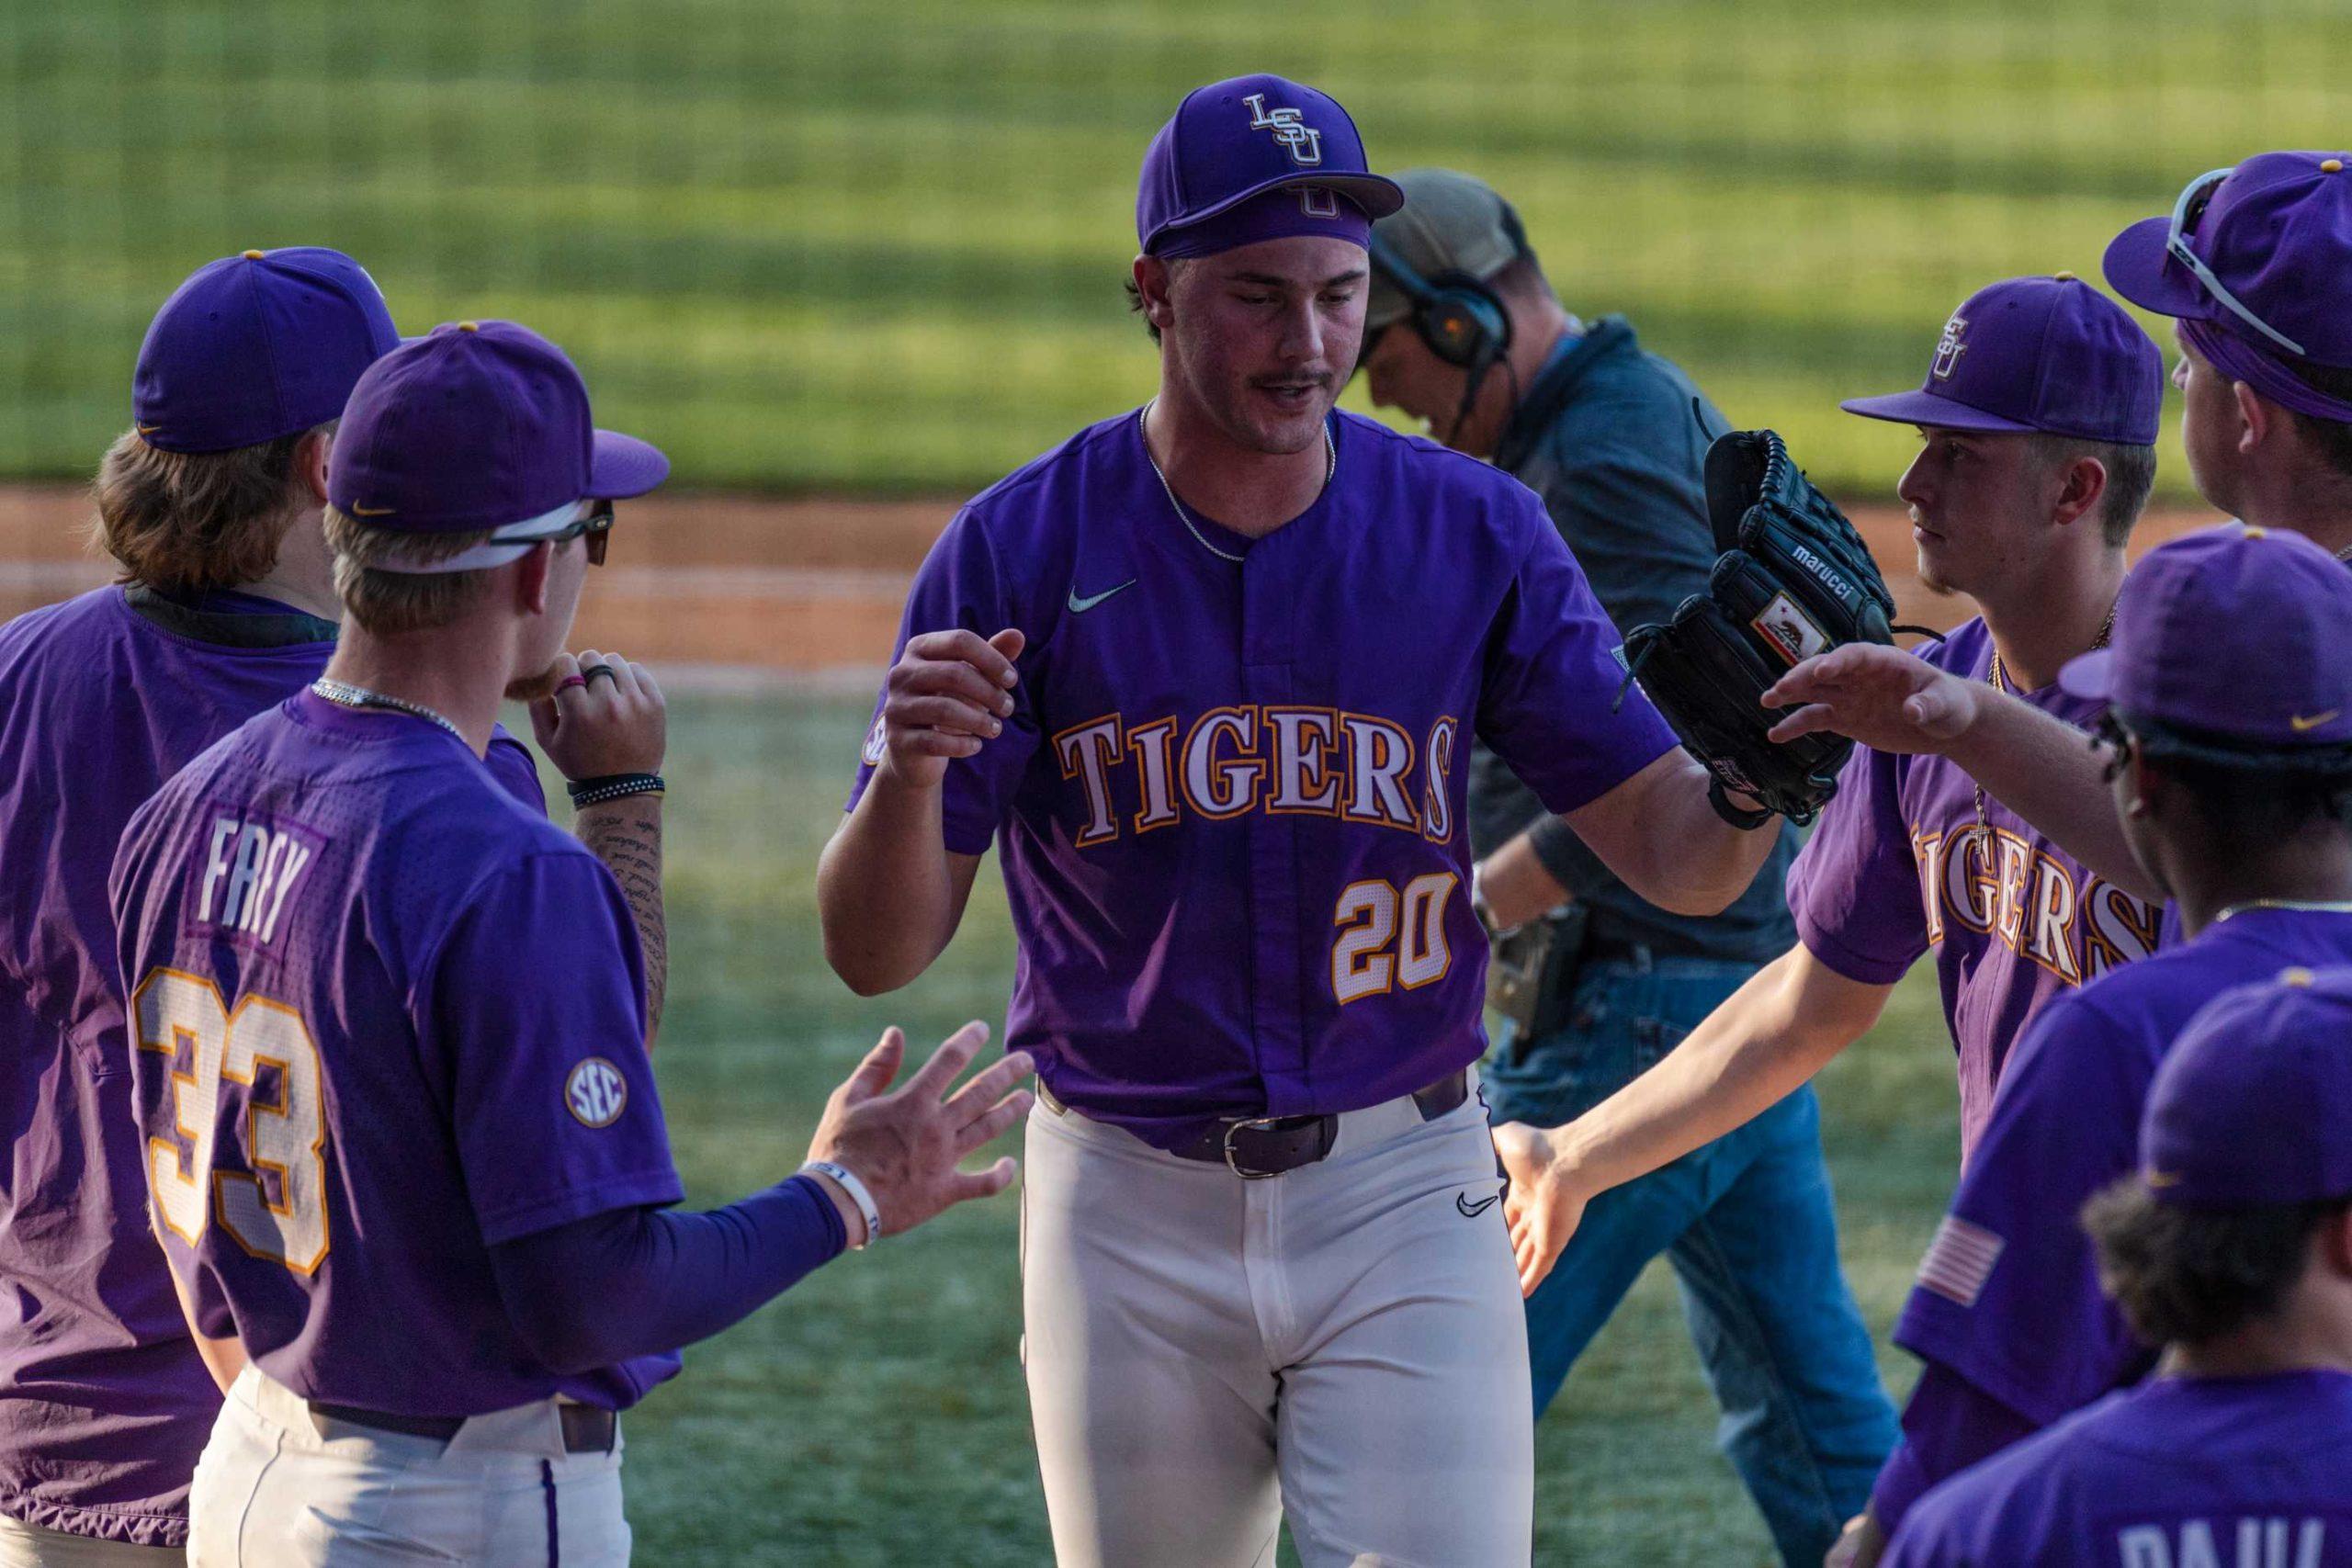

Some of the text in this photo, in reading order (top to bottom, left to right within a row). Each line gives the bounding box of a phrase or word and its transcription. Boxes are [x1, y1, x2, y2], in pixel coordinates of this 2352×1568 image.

[1242, 93, 1321, 166] LSU
[1792, 545, 1854, 600] marucci
[1052, 705, 1458, 845] TIGERS
[1331, 871, 1459, 1006] 20
[1910, 822, 2162, 989] IGERS
[132, 964, 330, 1278] 33
[570, 1062, 623, 1122] SEC
